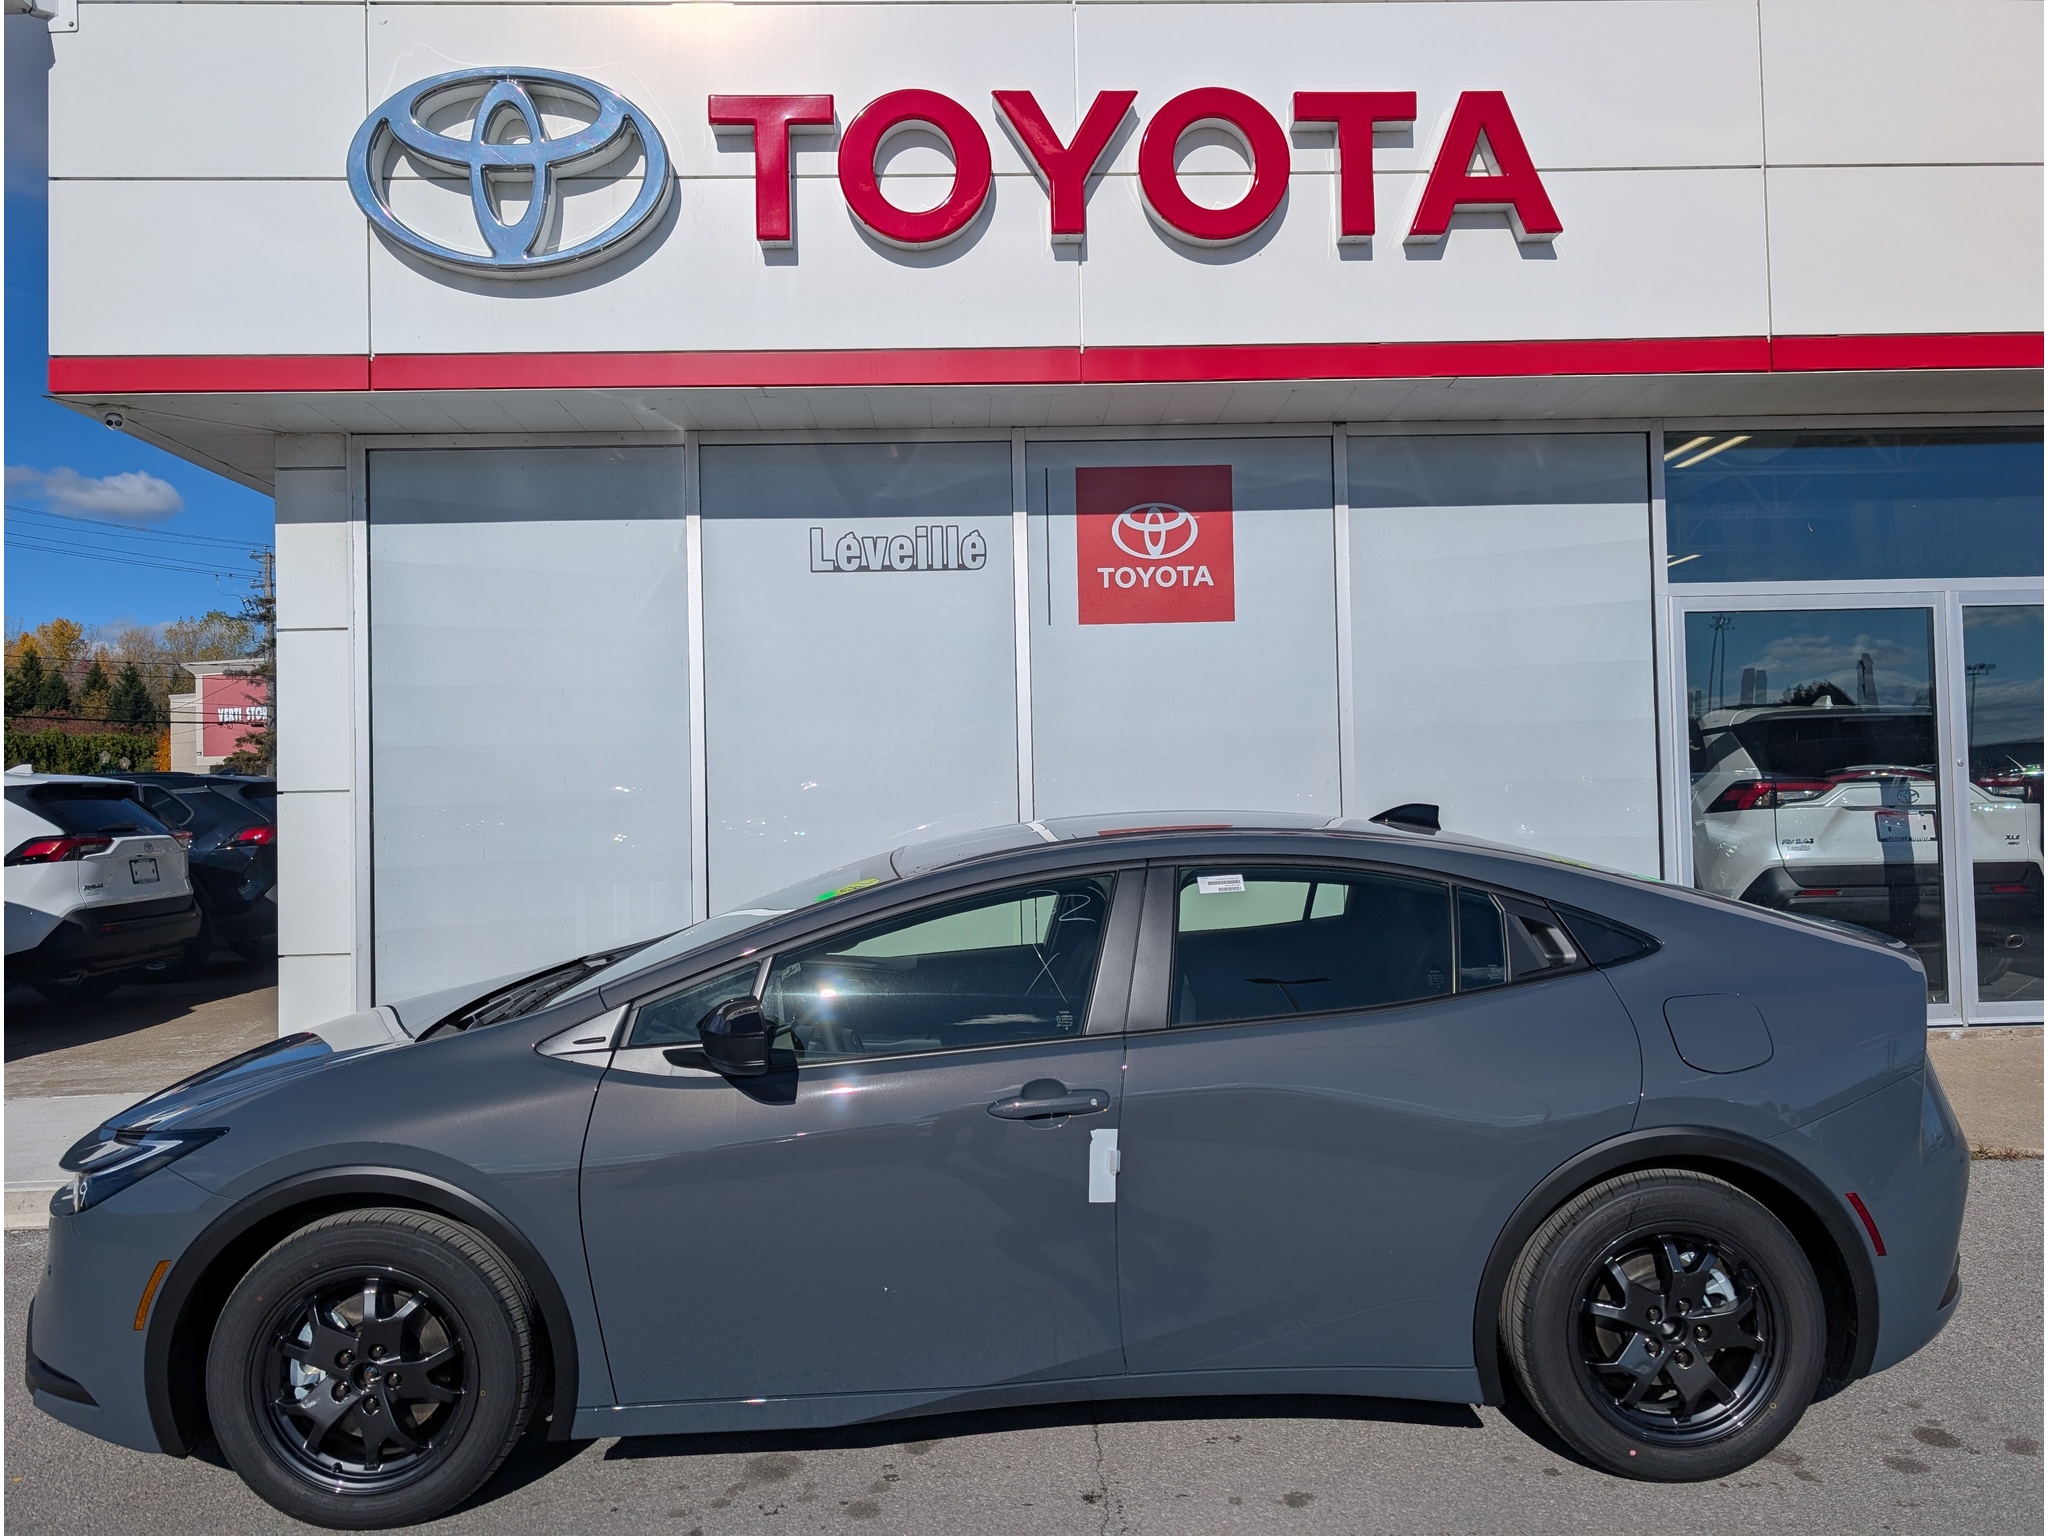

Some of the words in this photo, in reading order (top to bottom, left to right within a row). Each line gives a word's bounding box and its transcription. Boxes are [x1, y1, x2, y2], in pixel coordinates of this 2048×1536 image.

[708, 87, 1563, 248] TOYOTA
[809, 524, 987, 573] Léveillé
[1097, 565, 1215, 589] TOYOTA
